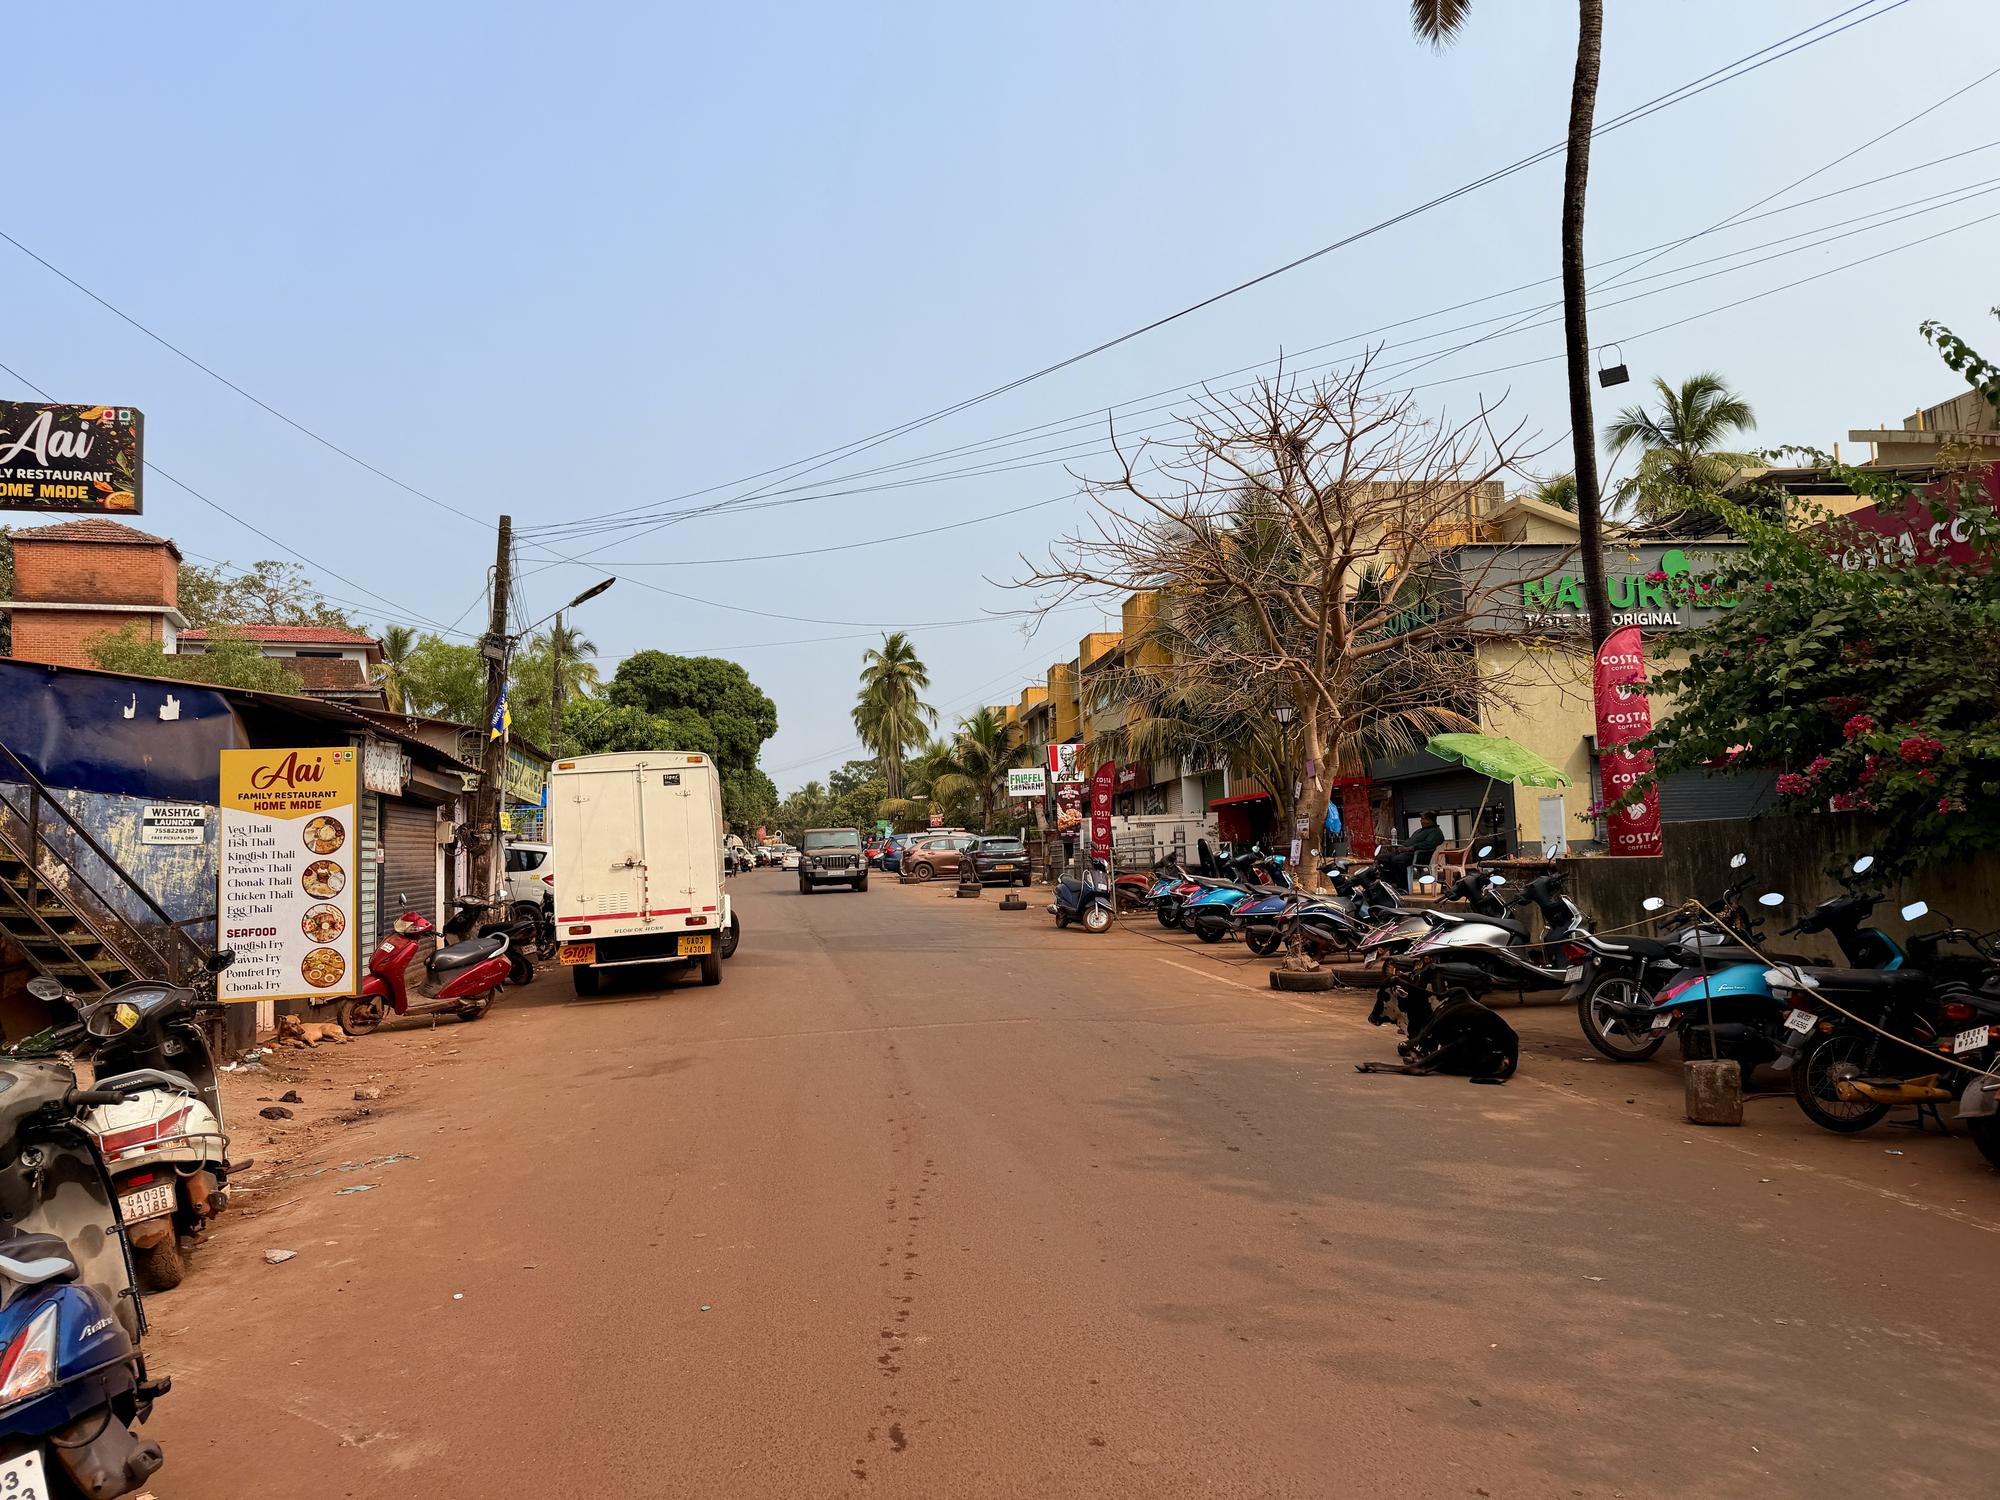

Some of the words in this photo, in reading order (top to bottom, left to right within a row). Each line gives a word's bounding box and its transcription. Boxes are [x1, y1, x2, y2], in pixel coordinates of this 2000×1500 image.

[0, 411, 94, 466] Aai
[16, 469, 112, 482] RESTAURANT
[40, 485, 88, 499] MADE
[1612, 612, 1681, 626] ORIGINAL
[1601, 654, 1640, 665] COSTA
[1608, 712, 1648, 724] COSTA
[251, 752, 325, 790] Aai
[1057, 773, 1080, 781] KFC
[275, 791, 337, 799] RESTAURANT
[254, 801, 286, 810] HOME
[290, 800, 322, 809] MADE
[152, 808, 200, 817] WASHTAG
[228, 825, 247, 837] Veg
[248, 824, 272, 833] Thali
[228, 838, 248, 847] Fish
[250, 838, 275, 846] Thali
[1618, 832, 1658, 844] COSTA
[228, 851, 268, 866] Kingfish
[272, 850, 295, 859] Thali
[228, 866, 264, 874] Prawns
[268, 864, 292, 872] Thali
[228, 878, 264, 887] Chonak
[268, 877, 292, 886] Thali
[227, 891, 266, 900] Chicken
[268, 890, 293, 899] Thali
[227, 906, 250, 921] Egg
[249, 904, 272, 914] Thali
[226, 927, 276, 938] SEAFOOD
[226, 941, 266, 956] Kingfish
[269, 940, 284, 950] Fry
[563, 946, 594, 958] STOP
[266, 954, 281, 964] Fry
[226, 968, 264, 978] Pomfret
[266, 968, 281, 977] Fry
[226, 982, 263, 992] Chonak
[266, 981, 281, 991] Fry
[112, 1079, 143, 1090] HONDA
